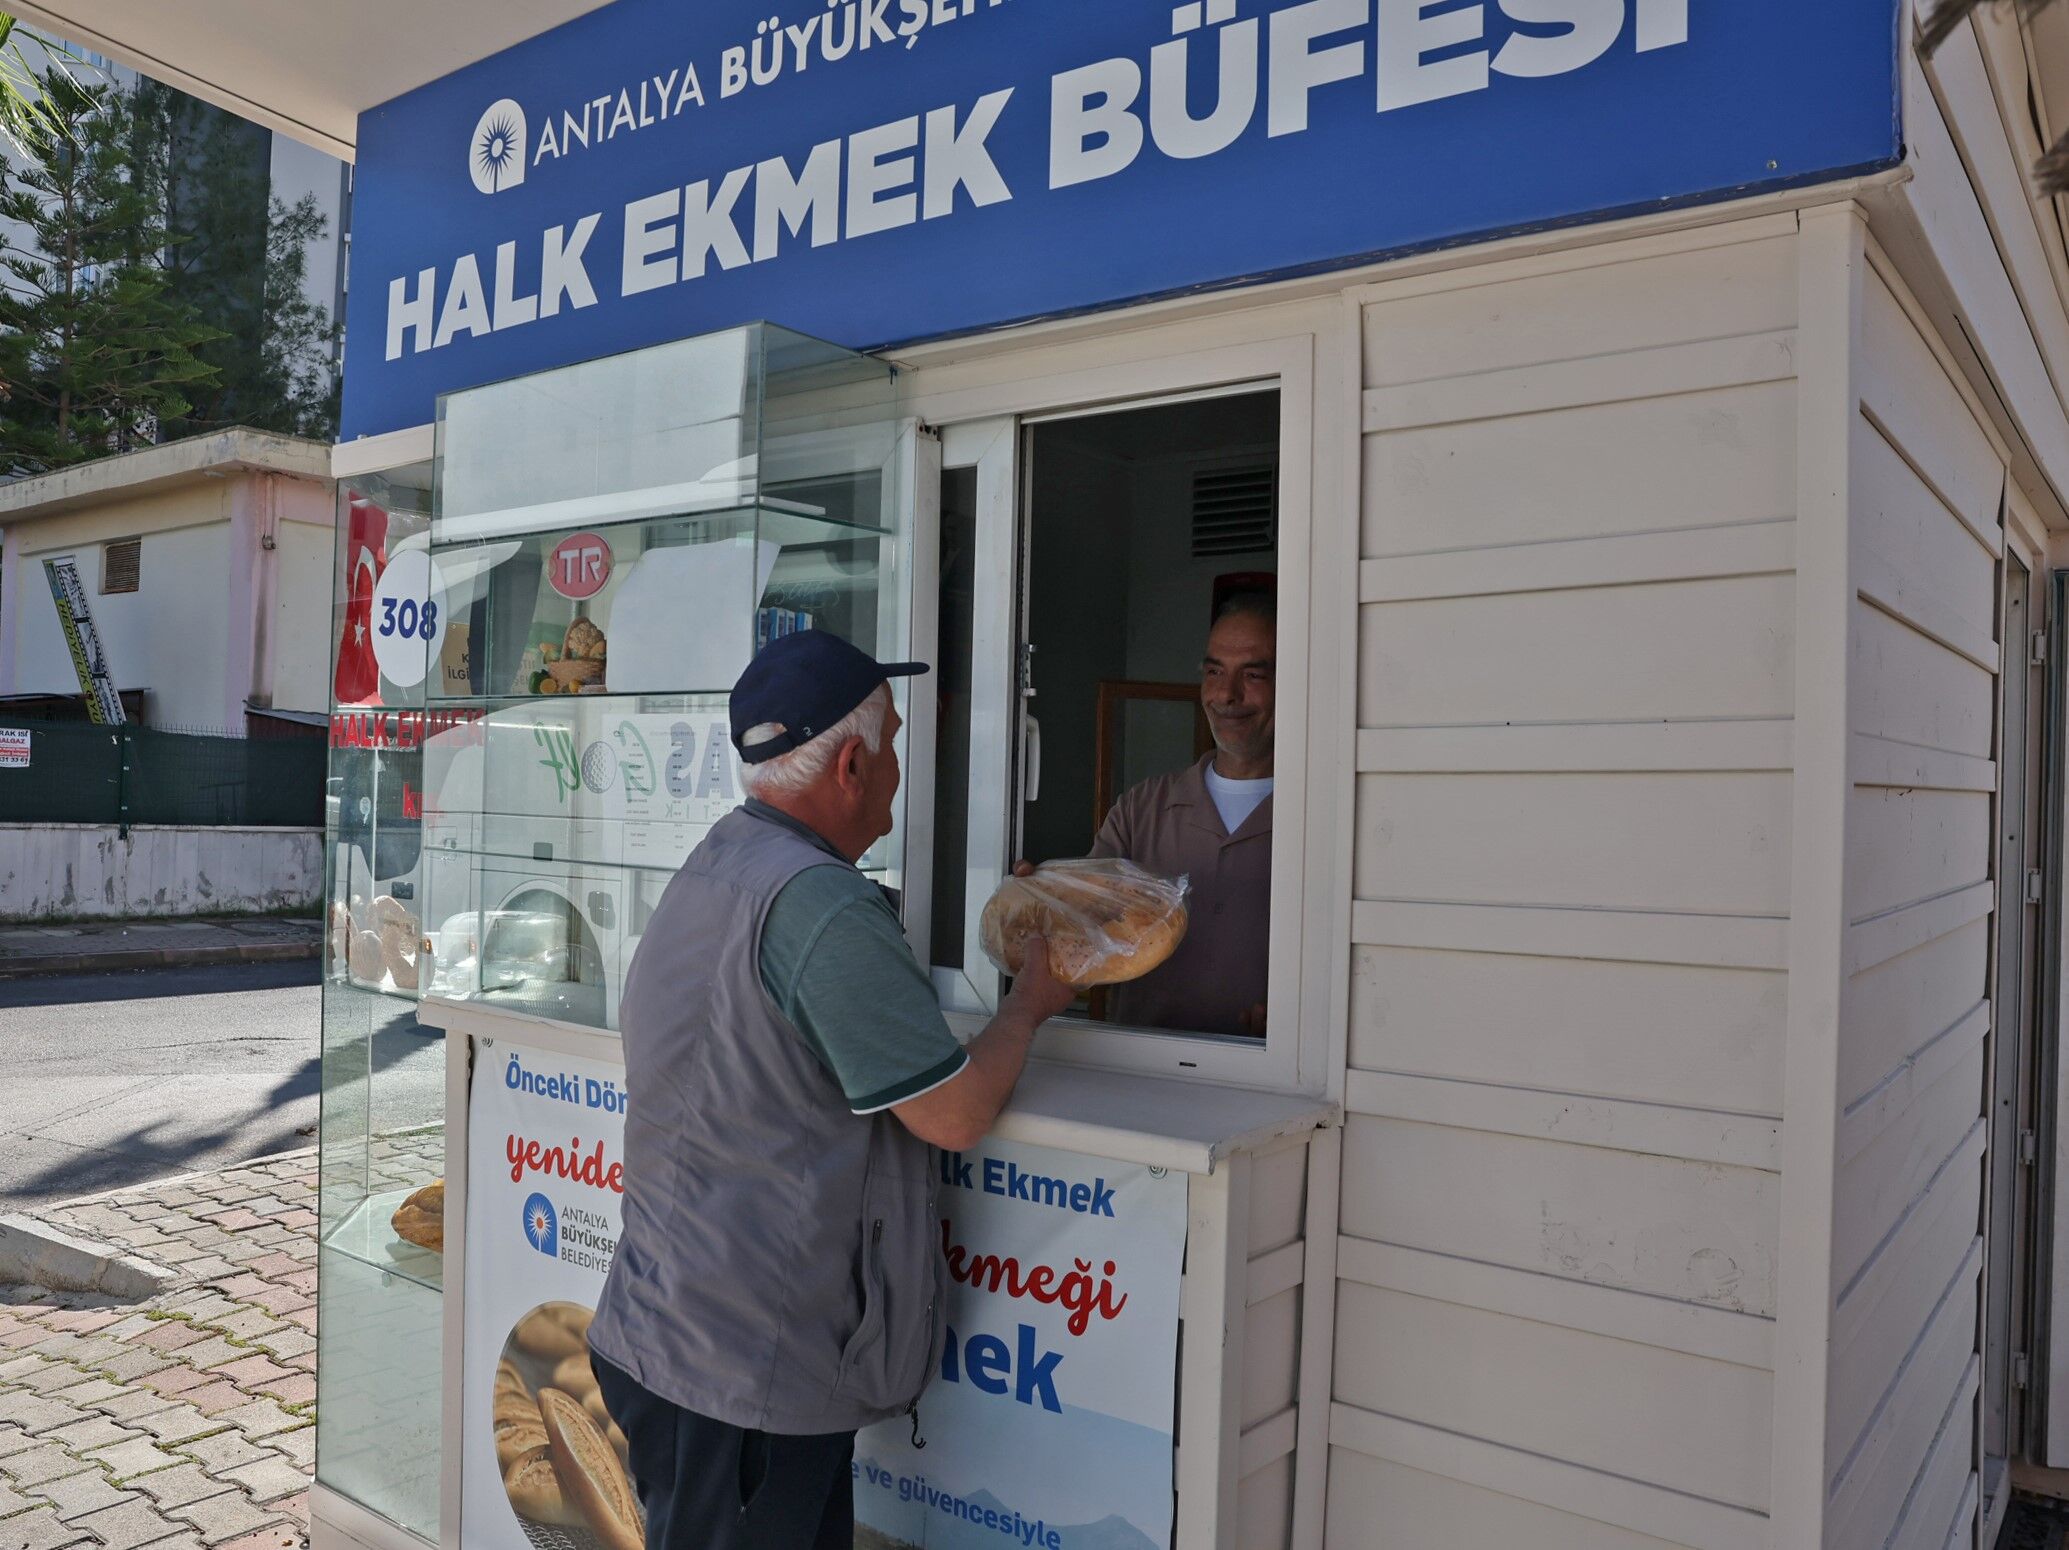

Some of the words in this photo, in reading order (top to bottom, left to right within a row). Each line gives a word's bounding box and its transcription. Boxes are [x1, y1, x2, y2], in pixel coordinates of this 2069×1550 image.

[534, 60, 705, 166] ANTALYA
[386, 212, 602, 362] HALK
[621, 87, 1015, 296] EKMEK
[557, 546, 603, 585] TR
[378, 597, 438, 640] 308
[329, 711, 389, 749] HALK
[396, 708, 487, 748] EKMEK
[505, 1053, 580, 1104] Önceki
[506, 1134, 625, 1194] yenide
[983, 1157, 1116, 1218] Ekmek
[561, 1205, 609, 1231] ANTALYA
[561, 1224, 617, 1255] BÜYÜKŞE
[865, 1464, 893, 1489] ve
[899, 1475, 1062, 1550] güvencesiyle
